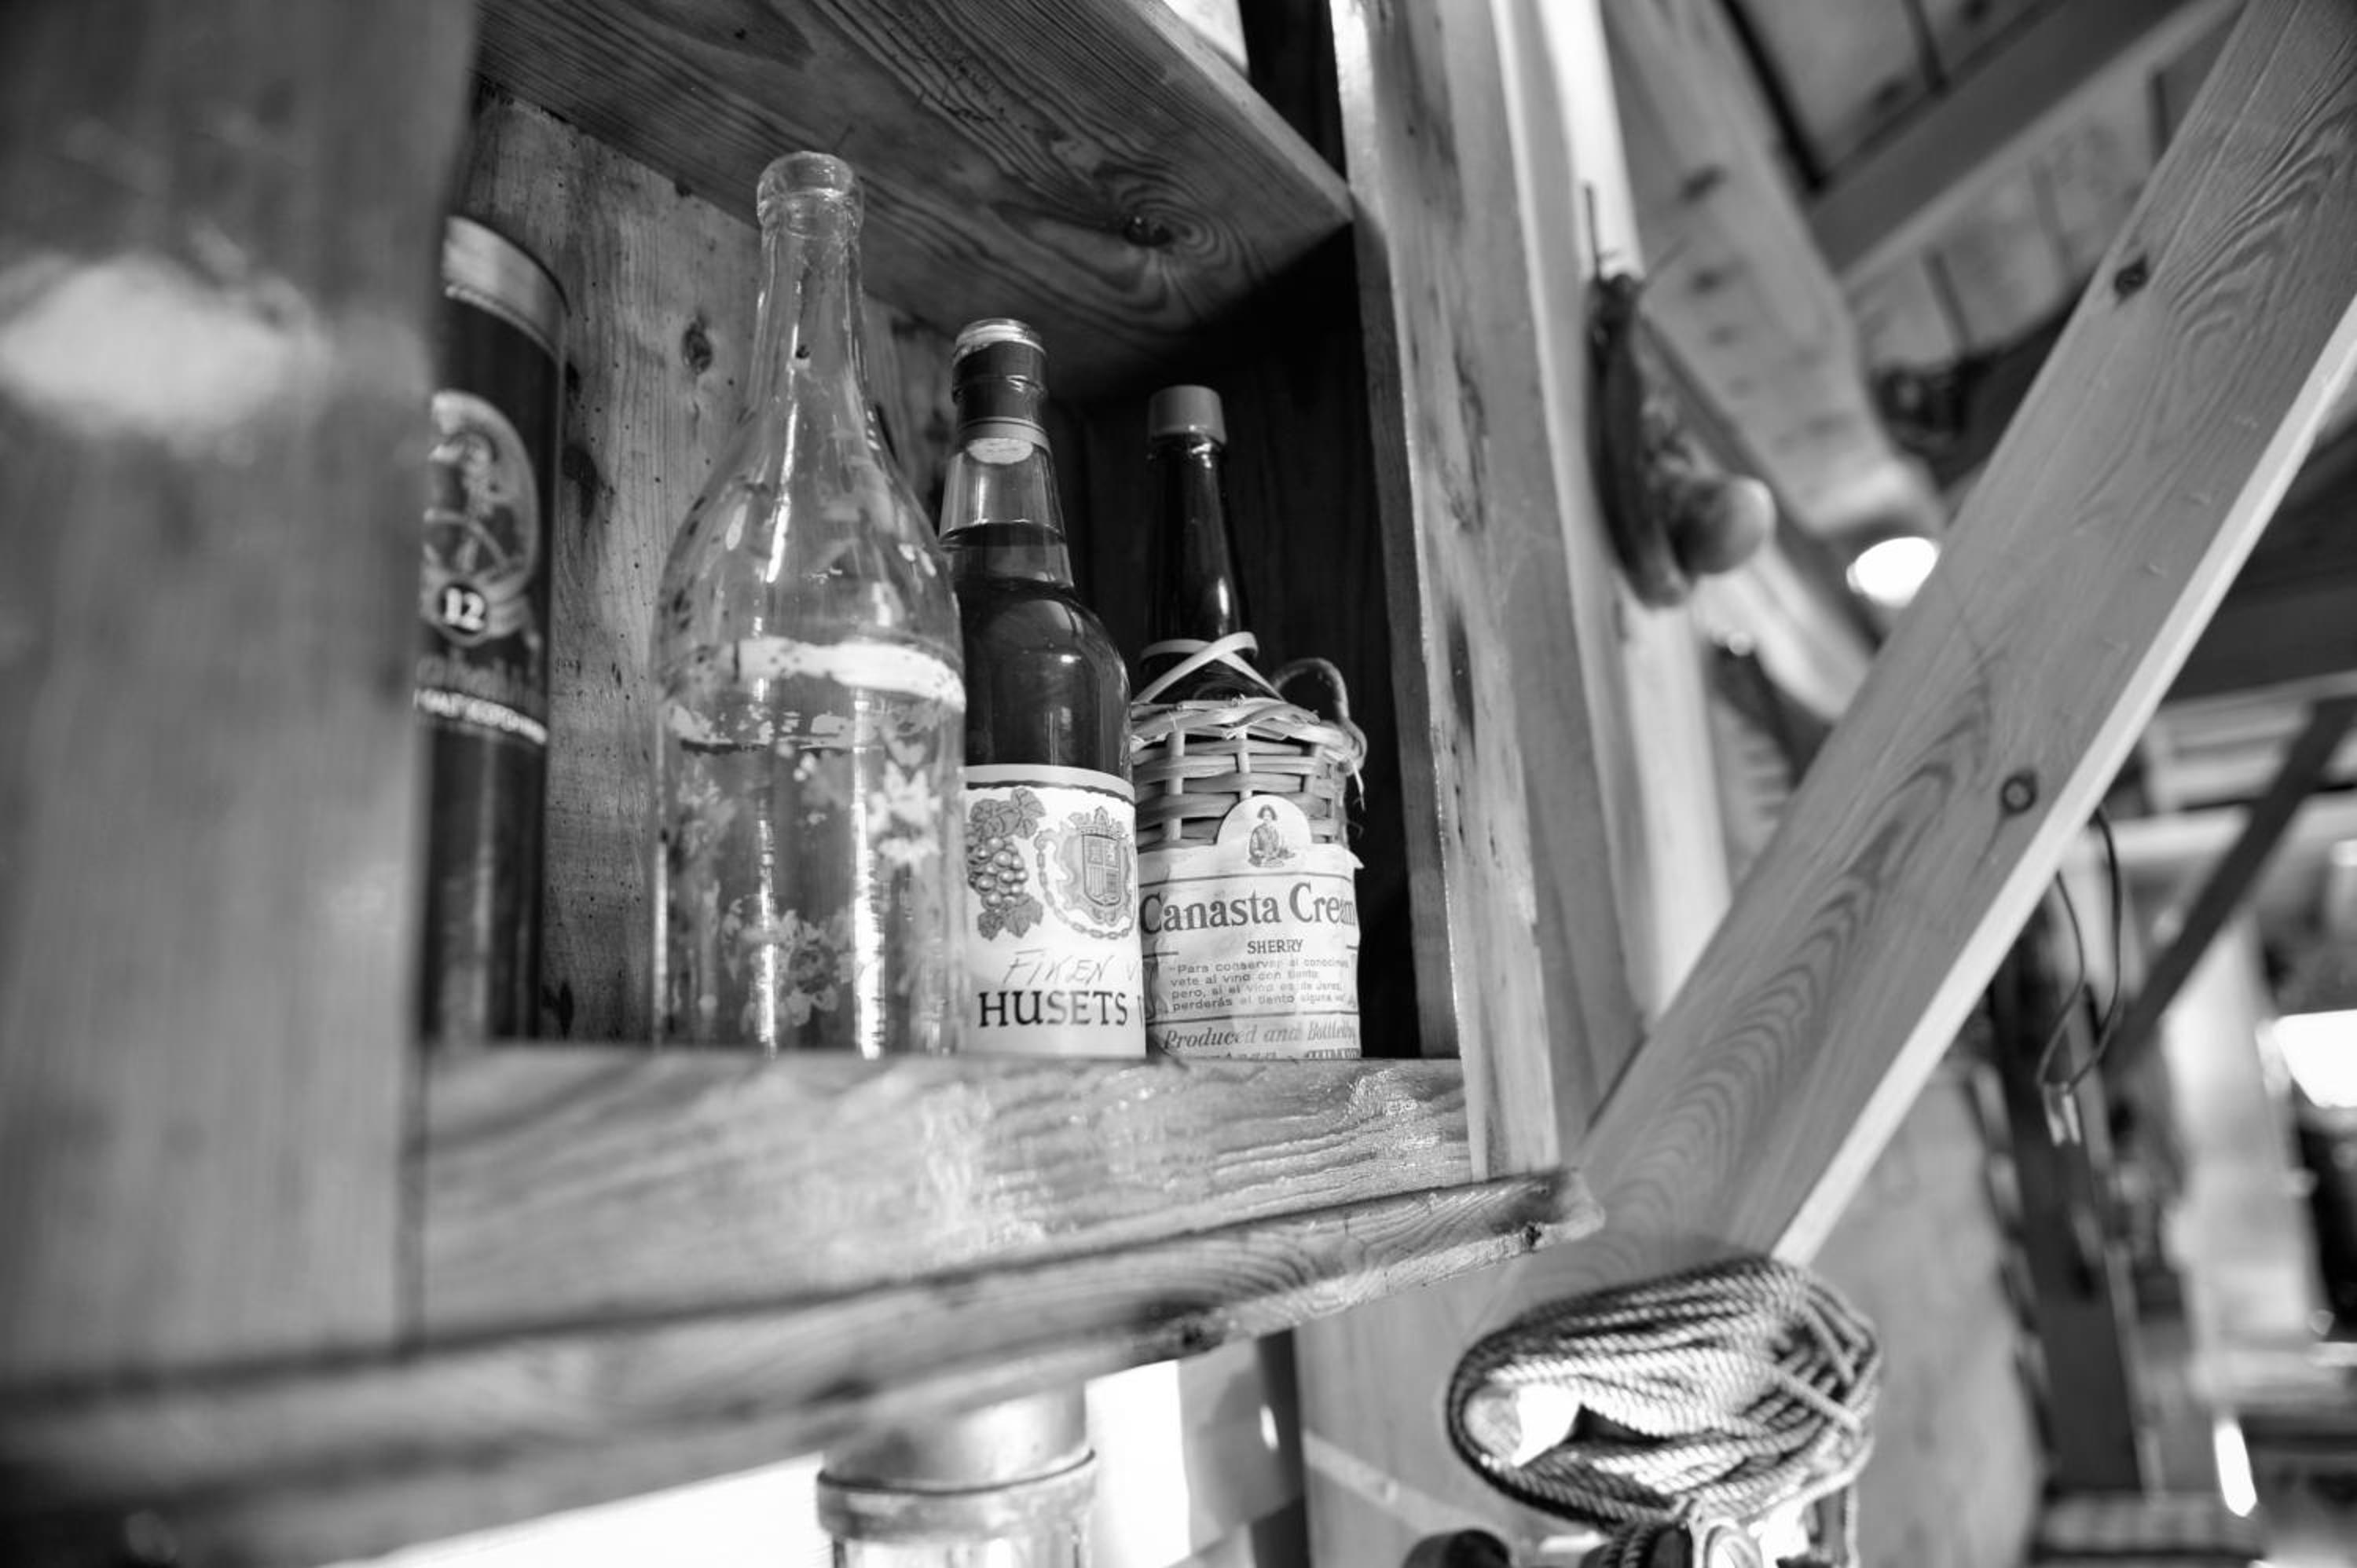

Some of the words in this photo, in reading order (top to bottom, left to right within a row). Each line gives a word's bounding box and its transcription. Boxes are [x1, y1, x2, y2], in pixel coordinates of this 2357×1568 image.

[445, 587, 485, 631] 12
[1140, 889, 1282, 935] Canasta
[1247, 939, 1303, 954] SHERRY
[1205, 974, 1217, 984] al
[1258, 971, 1281, 980] con
[979, 990, 1127, 1028] HUSETS
[1164, 1026, 1257, 1050] Produced
[1263, 1027, 1303, 1043] and
